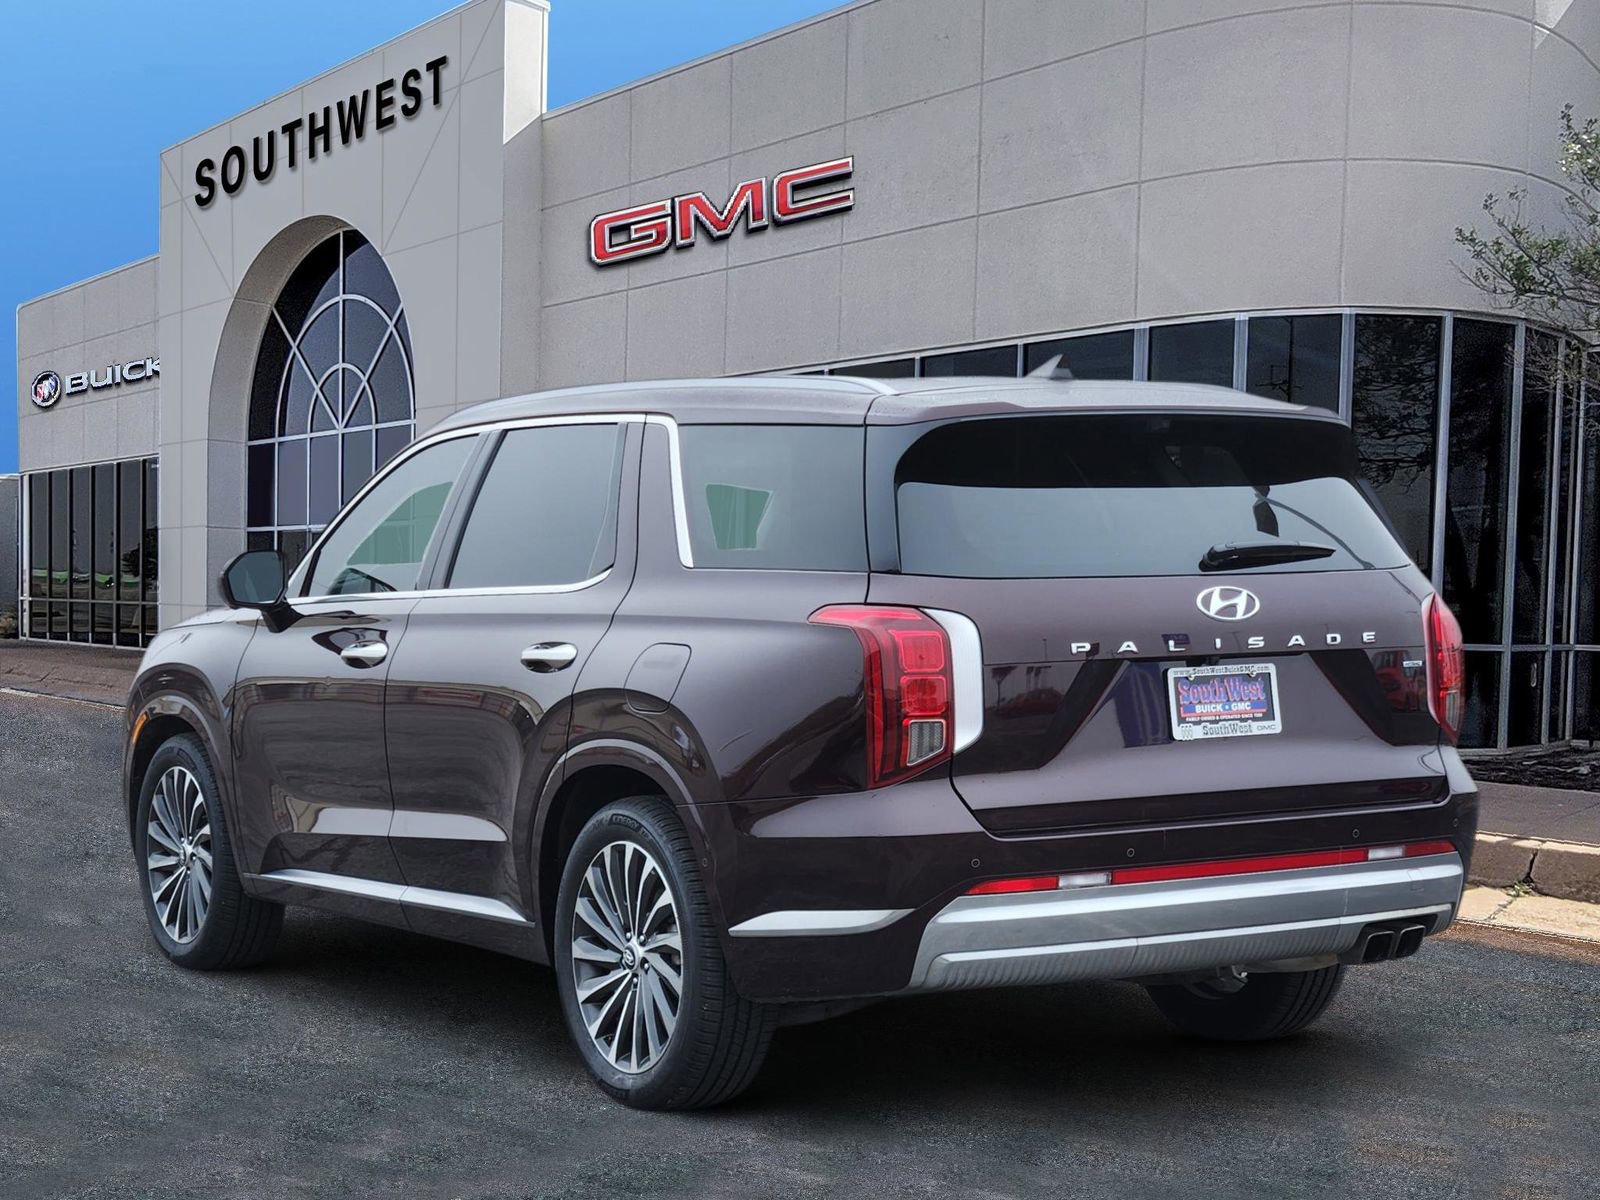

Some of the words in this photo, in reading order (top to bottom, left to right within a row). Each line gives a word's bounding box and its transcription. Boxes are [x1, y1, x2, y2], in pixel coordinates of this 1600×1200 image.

[194, 55, 448, 208] SOUTHWEST
[588, 155, 855, 267] GMC
[64, 357, 160, 395] BUICK
[1070, 631, 1377, 655] PALISADE
[1195, 704, 1223, 713] BUICK
[1231, 702, 1251, 711] GMC
